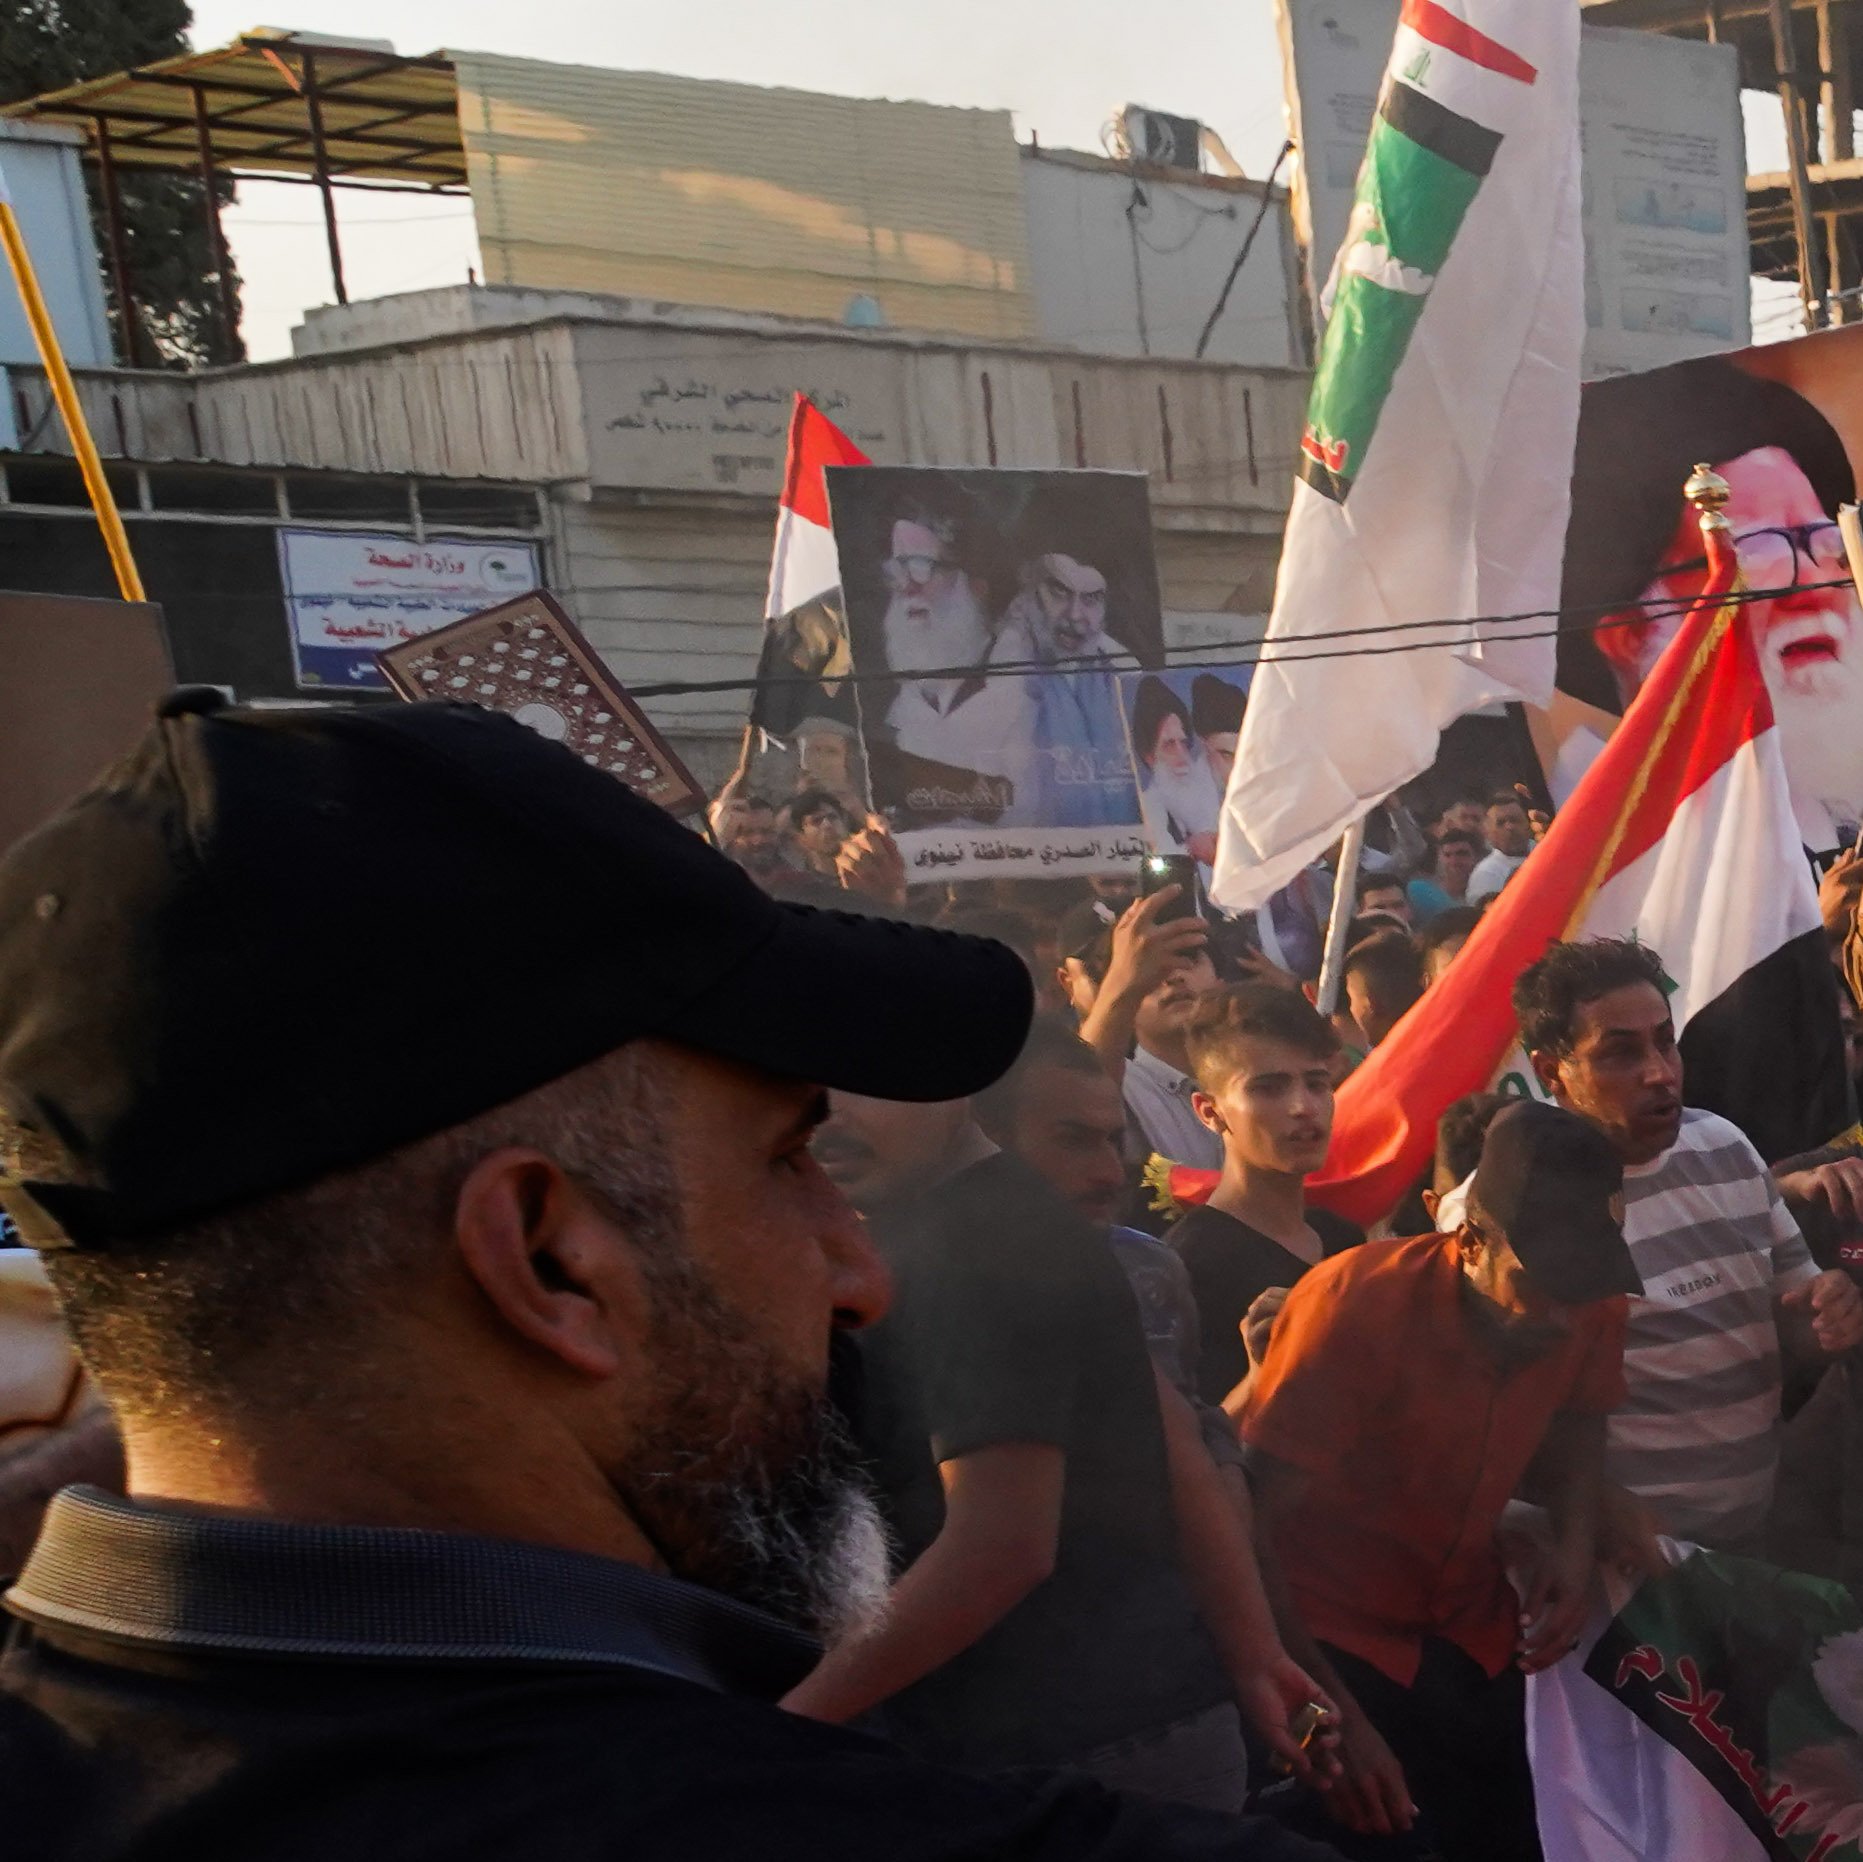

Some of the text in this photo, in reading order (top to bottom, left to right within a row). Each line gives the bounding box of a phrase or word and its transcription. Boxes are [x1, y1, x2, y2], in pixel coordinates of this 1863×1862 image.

[364, 546, 465, 574] وزارة الصحة
[322, 616, 394, 644] الشعبية
[970, 841, 1034, 861] محافظة
[1040, 839, 1101, 865] الصدري
[1614, 1643, 1811, 1839] السلام
